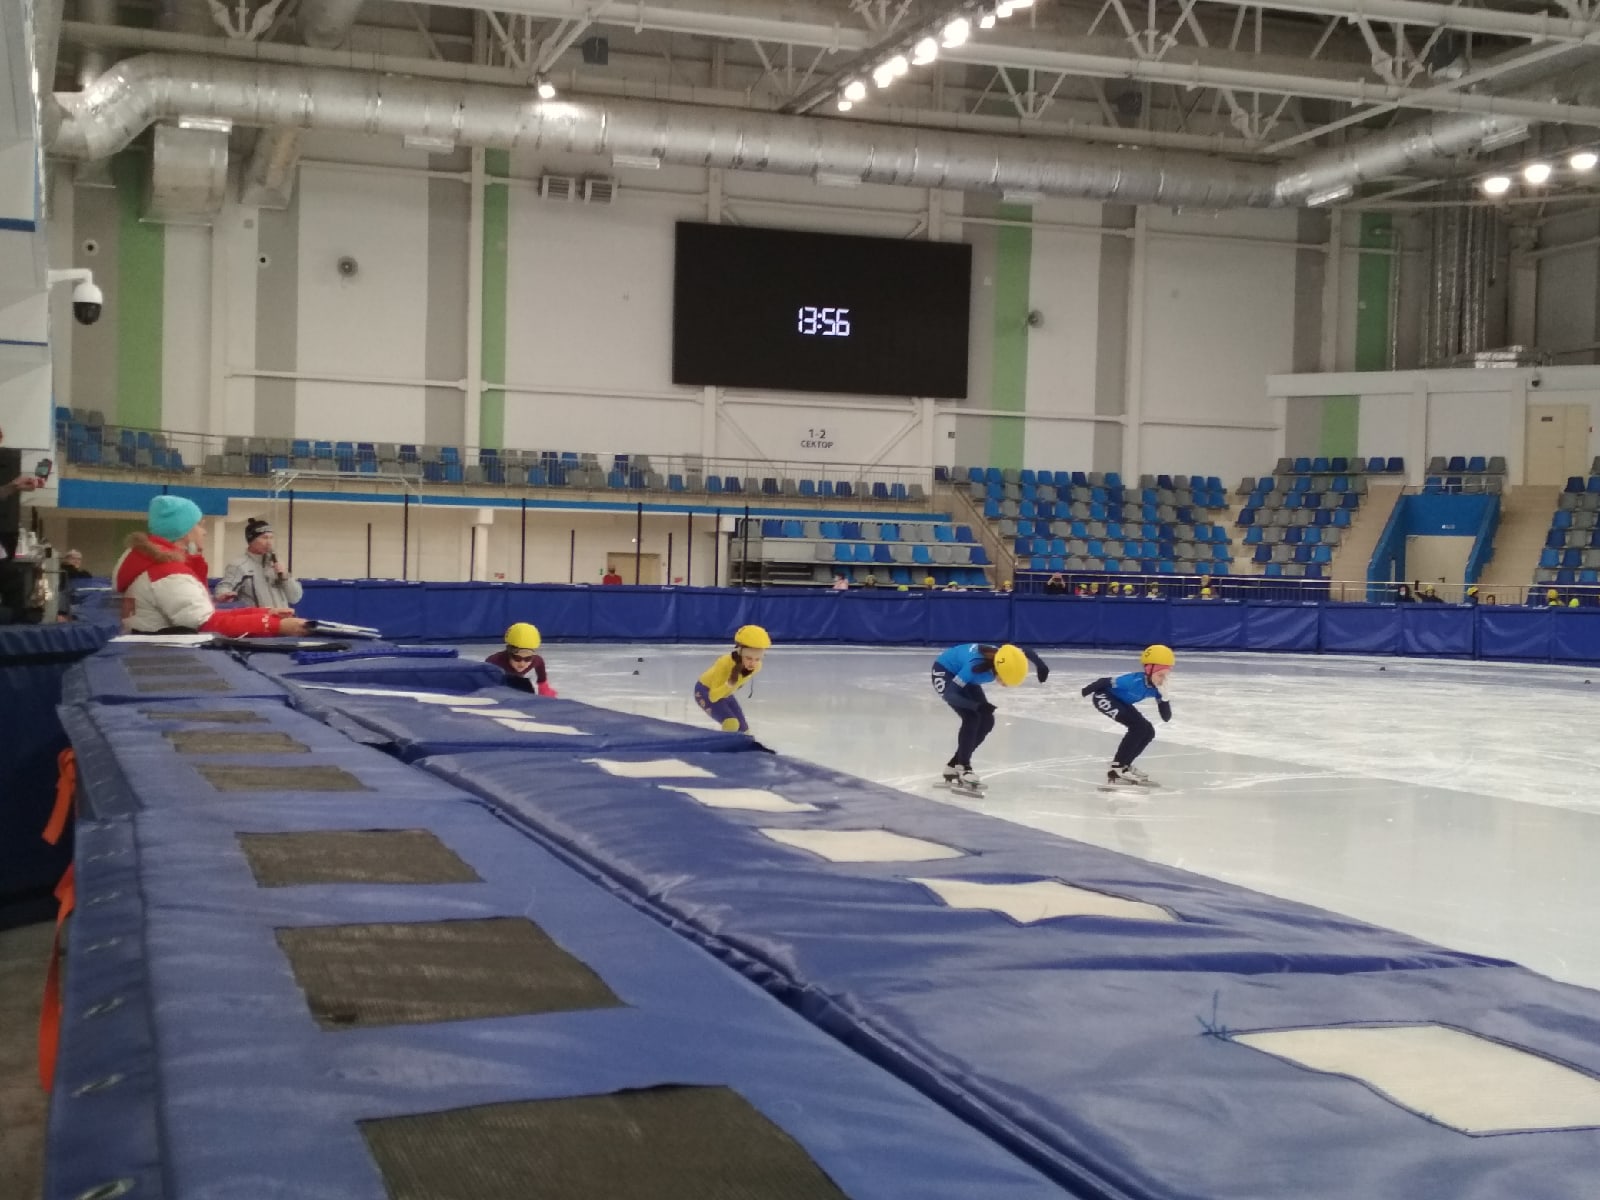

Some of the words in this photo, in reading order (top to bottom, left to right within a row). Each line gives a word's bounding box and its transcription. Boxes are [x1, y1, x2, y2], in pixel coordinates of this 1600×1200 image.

[798, 306, 850, 336] 13:56
[808, 429, 826, 439] 1-2
[800, 440, 834, 448] СЕКТОР
[1095, 693, 1119, 719] УФА
